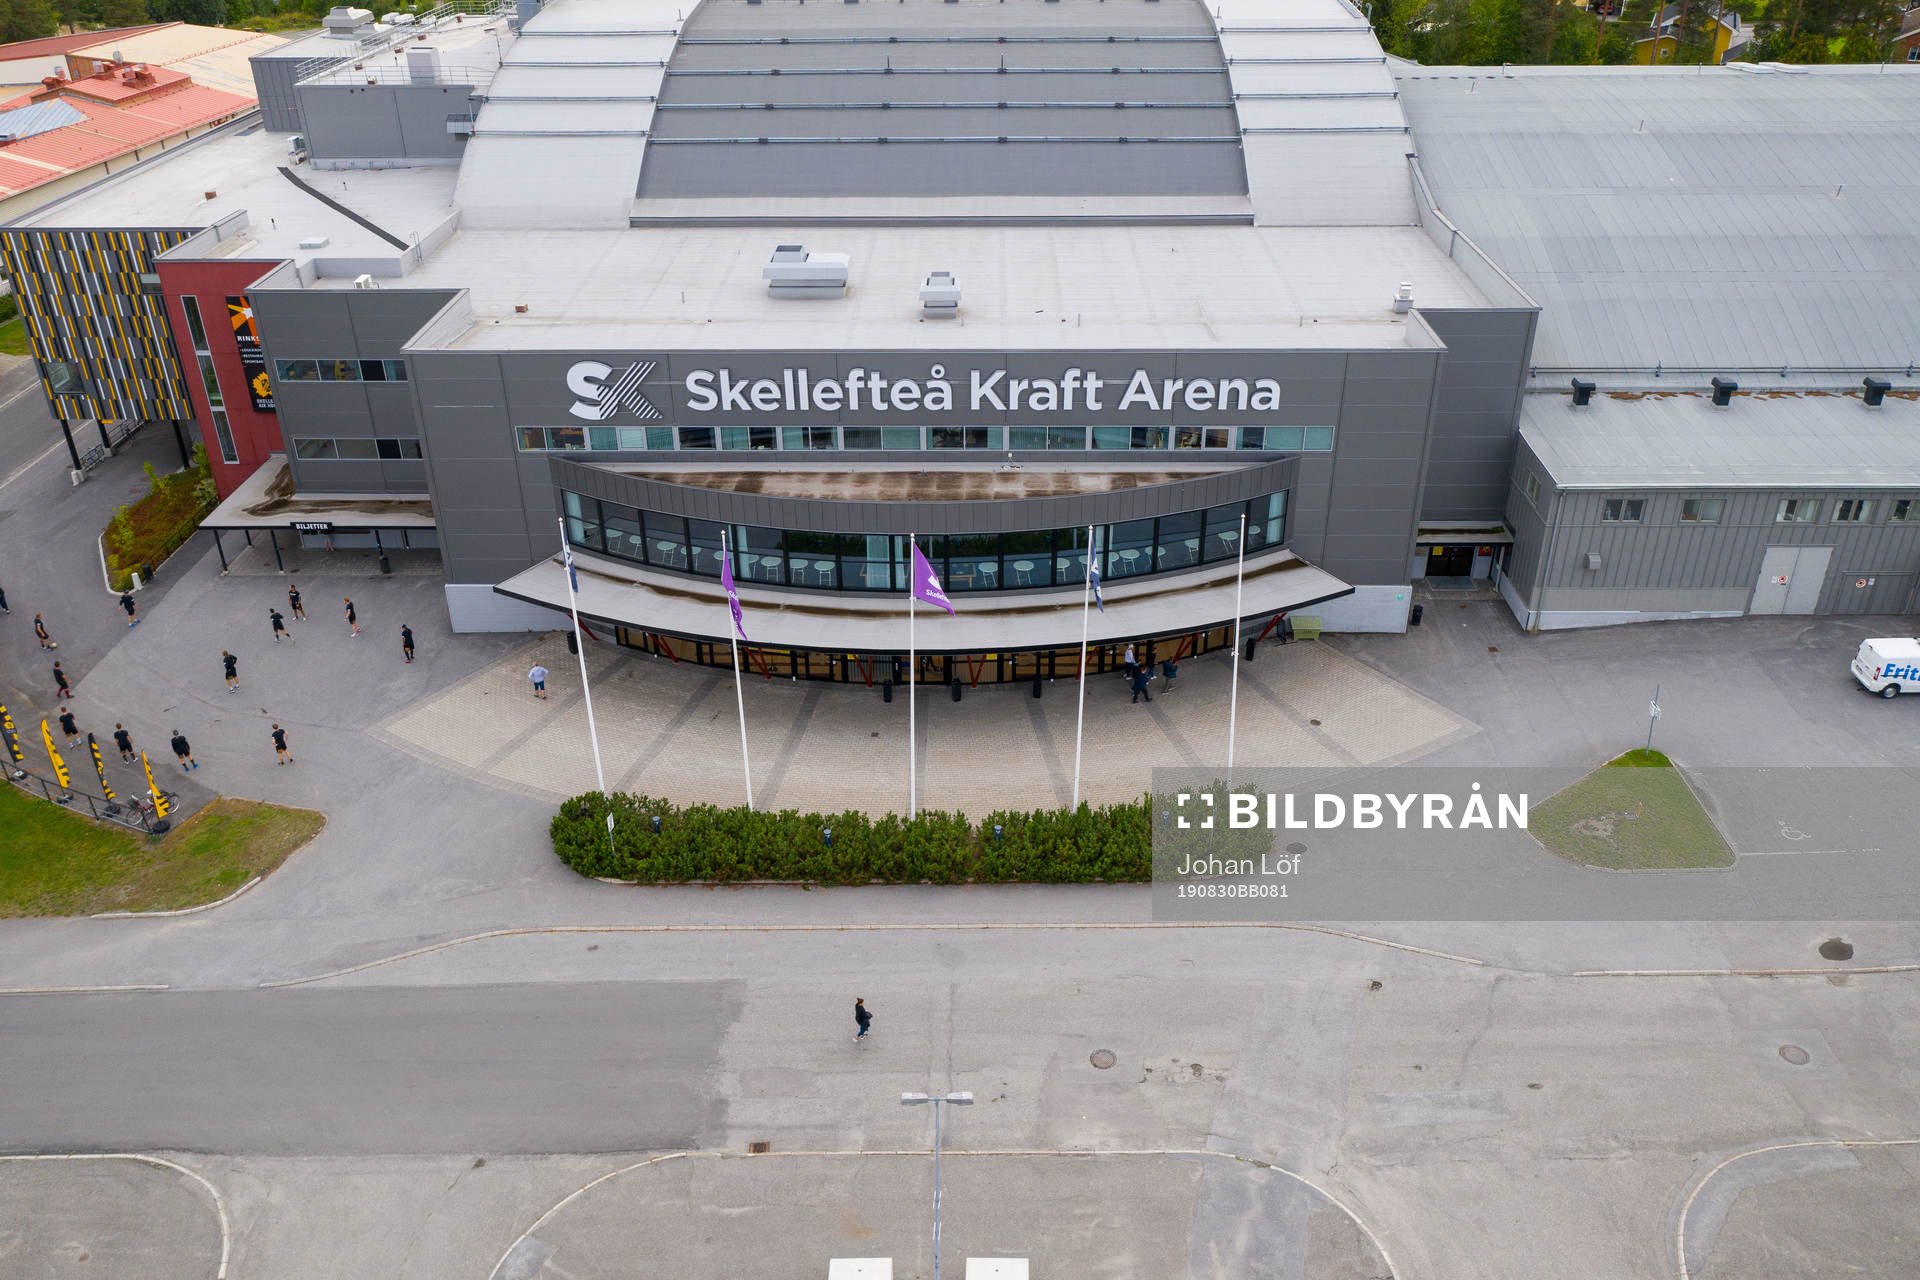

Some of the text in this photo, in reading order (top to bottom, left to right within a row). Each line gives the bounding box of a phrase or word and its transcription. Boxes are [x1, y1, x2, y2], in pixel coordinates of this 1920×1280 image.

[685, 363, 1282, 412] Skellefteå Kraft Arena
[1882, 663, 1920, 682] Frit
